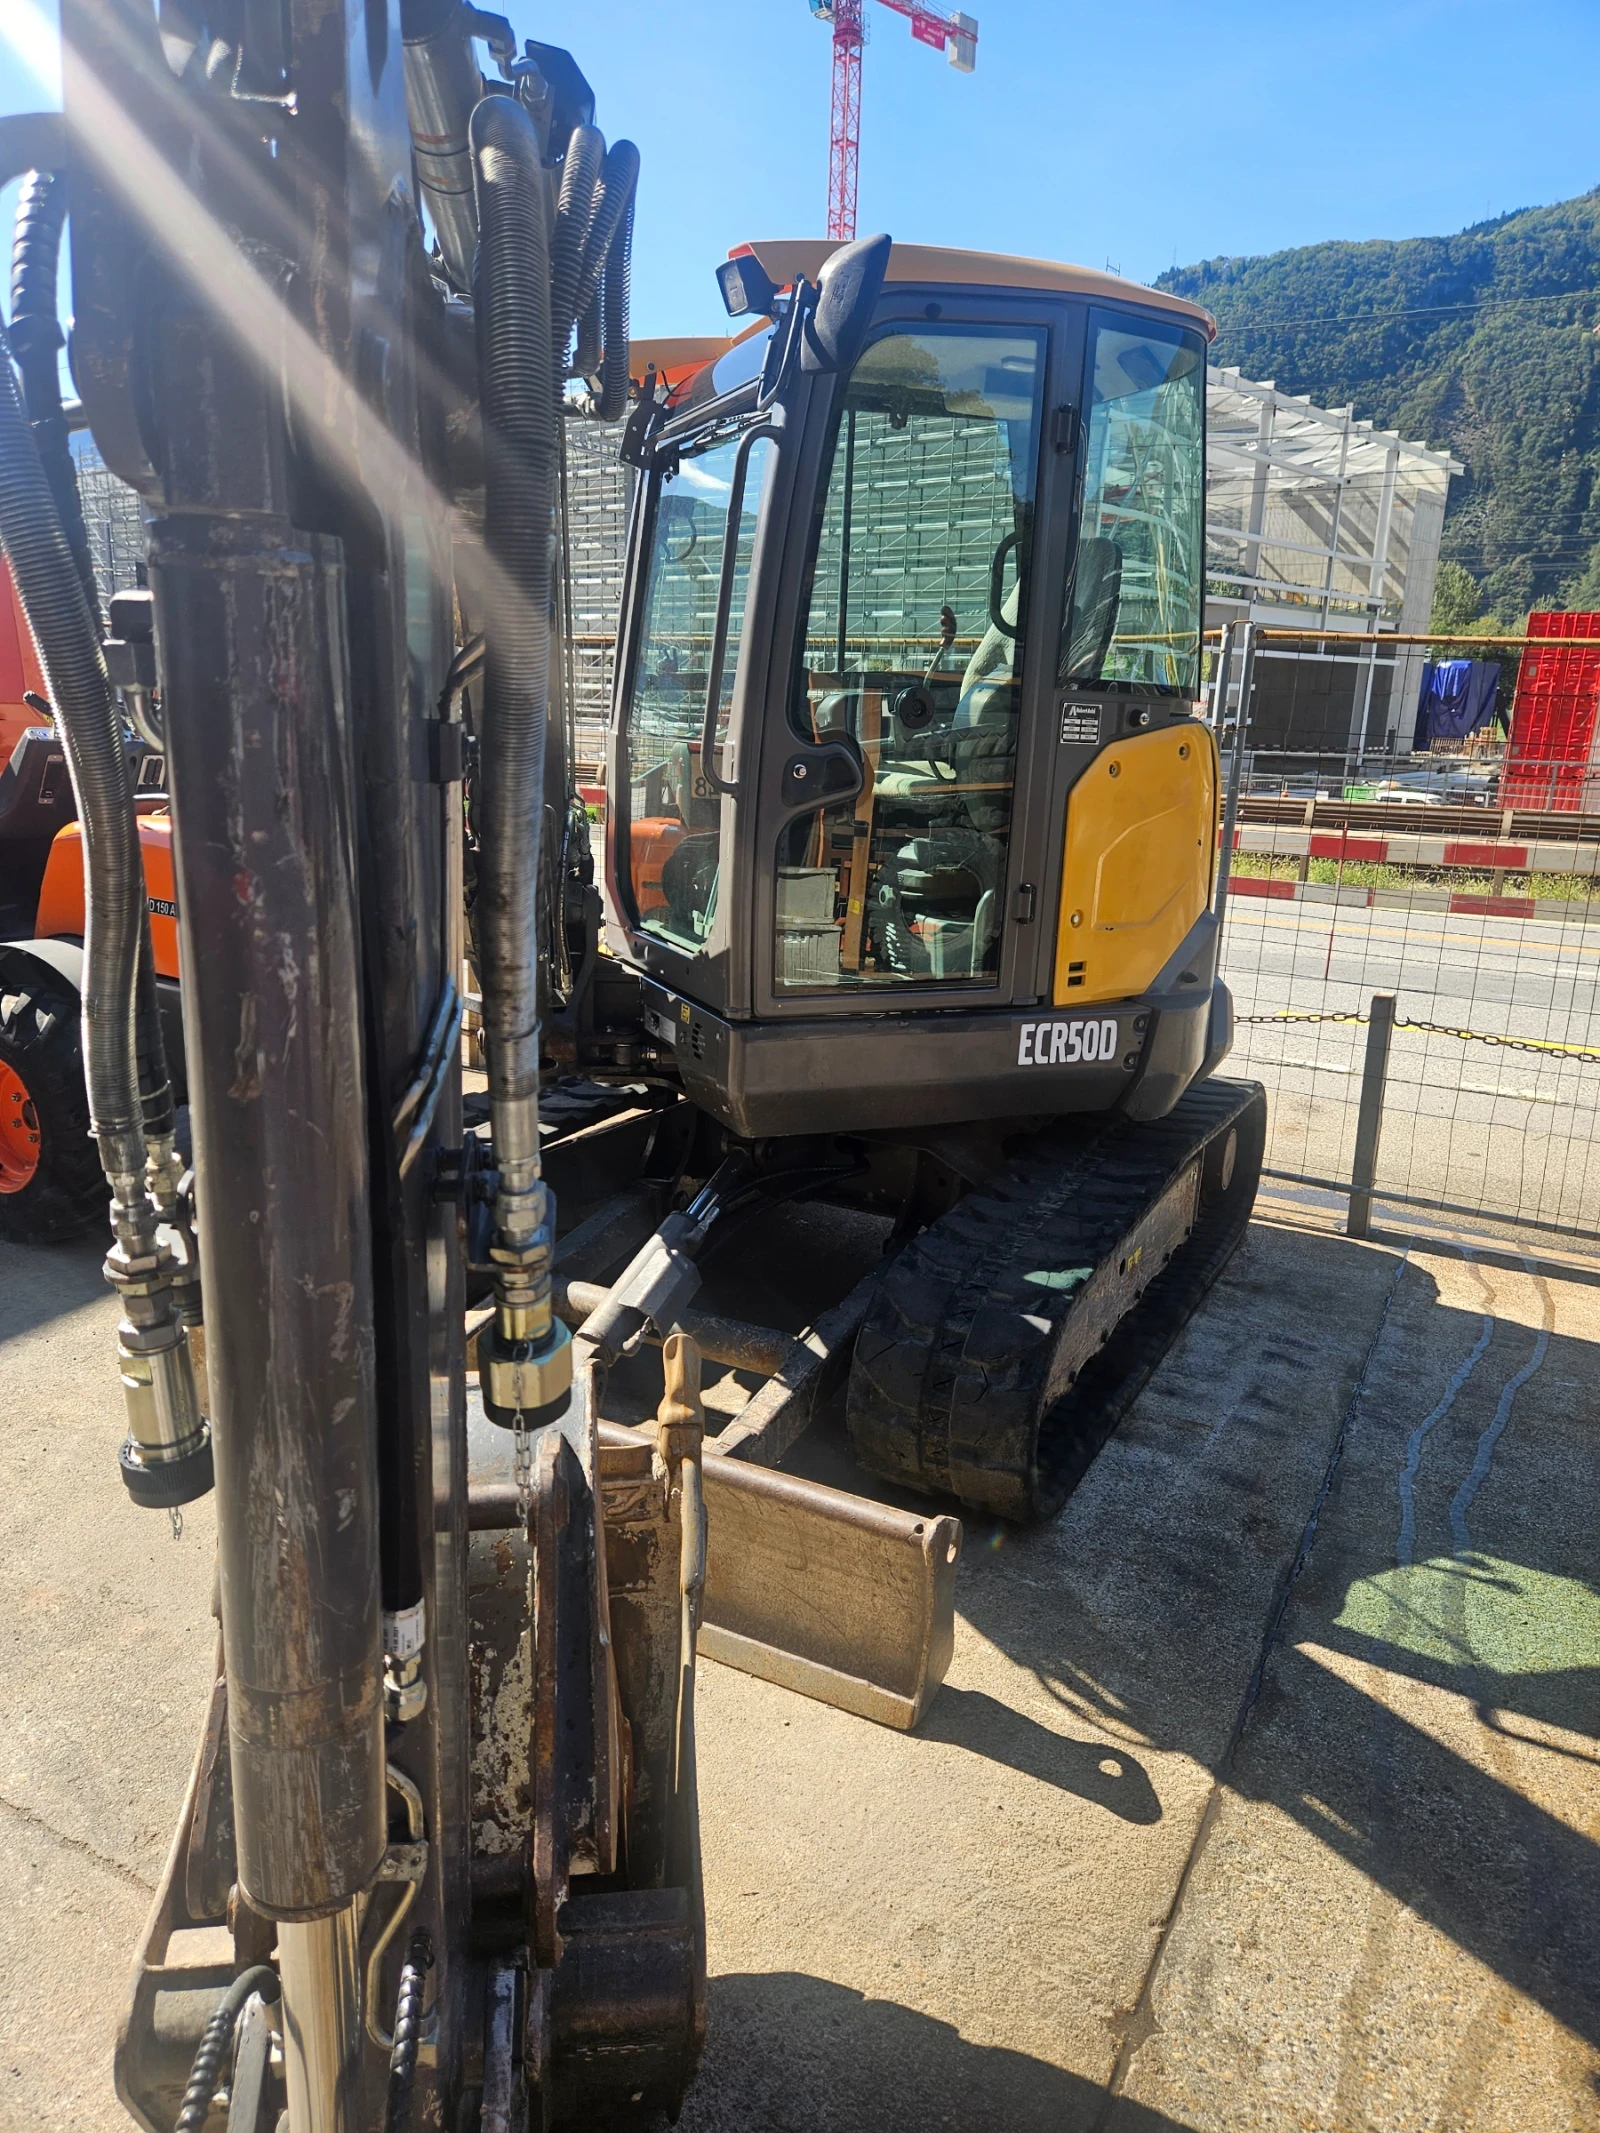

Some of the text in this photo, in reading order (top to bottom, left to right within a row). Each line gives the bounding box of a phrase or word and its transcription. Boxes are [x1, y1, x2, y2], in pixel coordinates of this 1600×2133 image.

[149, 900, 176, 916] D 150 A
[1018, 1020, 1117, 1065] ECR50D
